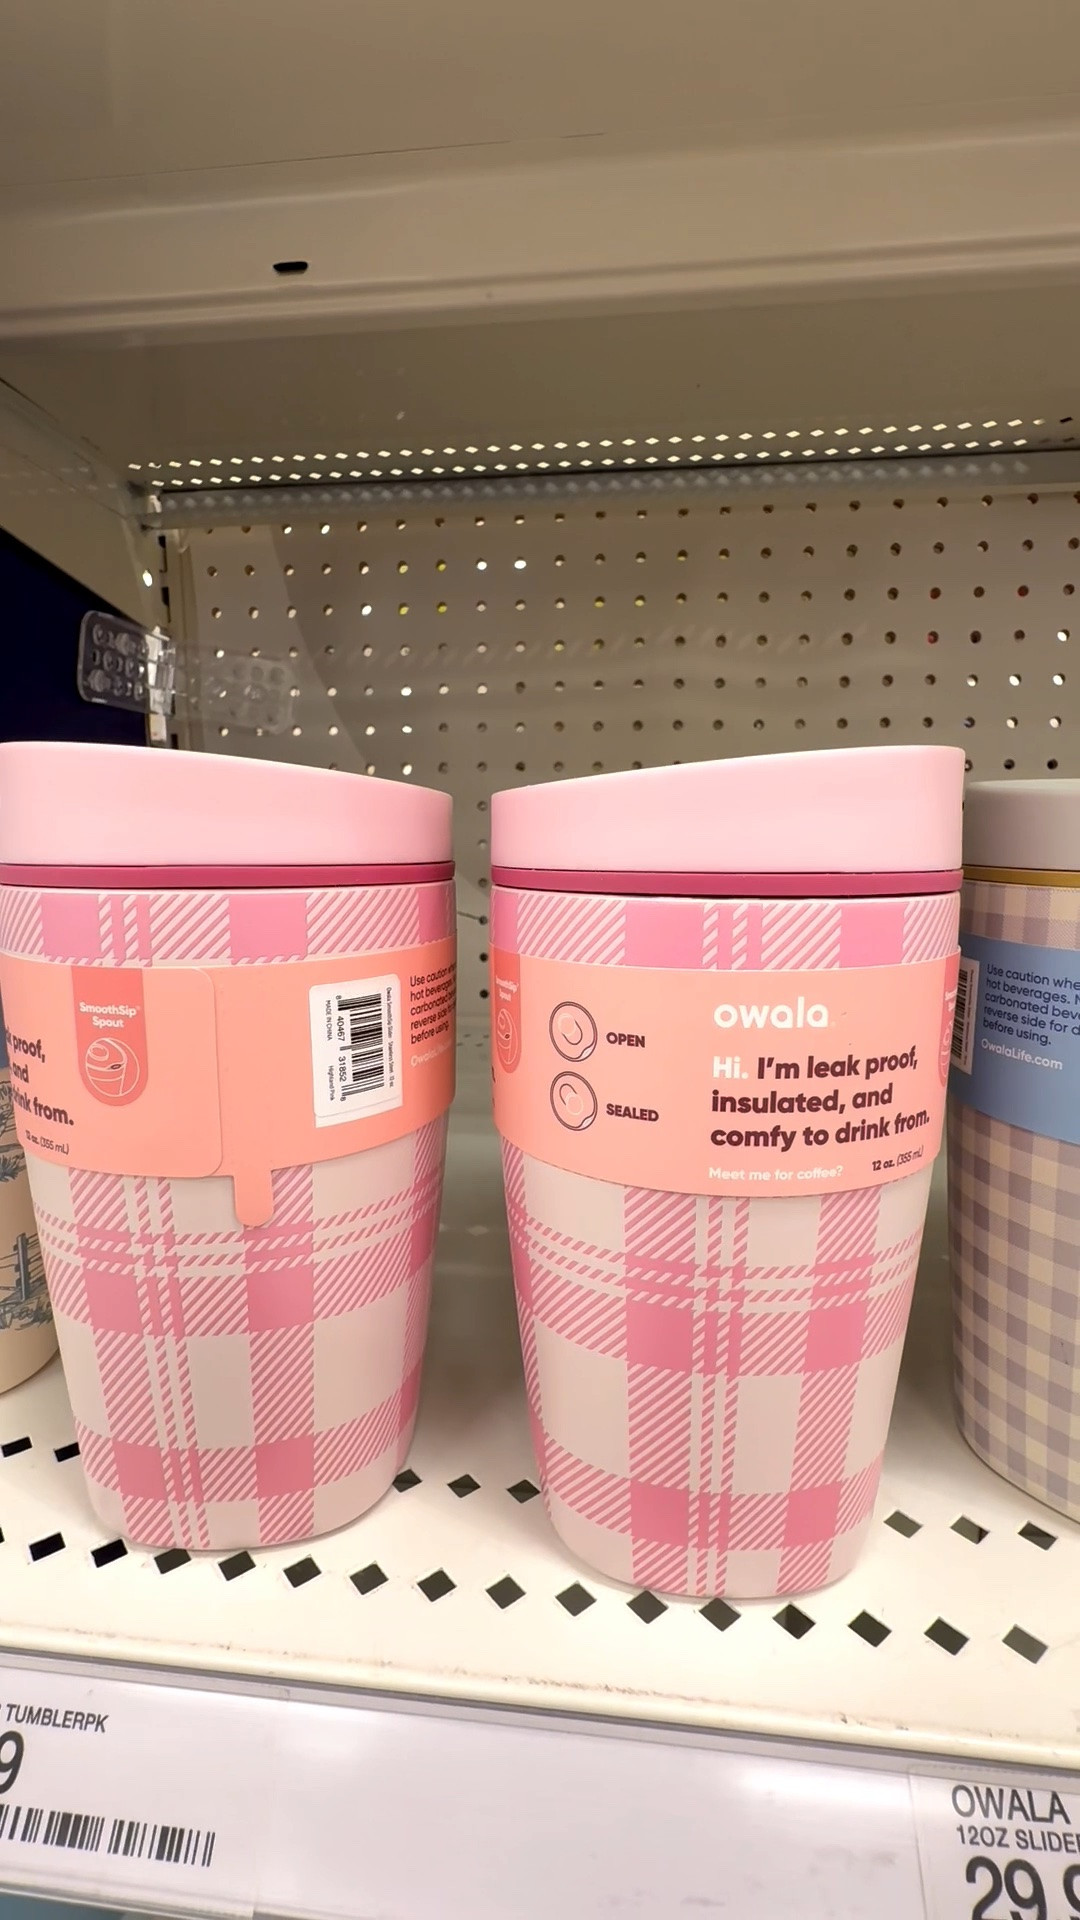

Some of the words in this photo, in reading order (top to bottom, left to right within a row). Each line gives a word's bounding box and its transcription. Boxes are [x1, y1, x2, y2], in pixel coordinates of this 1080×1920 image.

[410, 976, 425, 988] Use
[987, 964, 1003, 977] Use
[1006, 968, 1050, 985] caution
[410, 989, 424, 1002] hot
[986, 978, 1001, 990] hot
[1003, 981, 1070, 1004] beverages.
[713, 996, 829, 1029] owala
[984, 991, 1049, 1015] carbonated
[1052, 1005, 1080, 1020] bev
[92, 1015, 124, 1029] Spout
[337, 1016, 345, 1041] 40467
[411, 1012, 436, 1031] reverse
[983, 1017, 1014, 1035] before
[1016, 1026, 1052, 1046] using.
[984, 1005, 1019, 1022] reverse
[1021, 1014, 1046, 1029] side
[1050, 1020, 1068, 1033] for
[411, 1027, 435, 1044] before
[606, 1032, 645, 1048] OPEN
[12, 1034, 45, 1063] proof,
[981, 1038, 1063, 1070] OwalaLife.com
[12, 1061, 29, 1083] and
[713, 1055, 749, 1079] Hi.
[807, 1054, 861, 1078] leak
[865, 1045, 918, 1080] proof,
[711, 1089, 846, 1114] insulated,
[851, 1082, 893, 1109] and
[33, 1096, 74, 1126] from.
[606, 1103, 659, 1122] SEALED
[710, 1125, 797, 1152] comfy
[802, 1126, 829, 1146] to
[835, 1116, 890, 1144] drink
[894, 1109, 930, 1135] from.
[40, 1136, 54, 1150] (355
[55, 1143, 70, 1155] mL)
[708, 1167, 745, 1180] Meet
[749, 1168, 771, 1180] me
[774, 1167, 793, 1180] for
[797, 1165, 843, 1180] coffee?
[872, 1160, 882, 1171] 12
[883, 1159, 895, 1169] oz.
[897, 1150, 912, 1167] (355
[6, 1703, 109, 1733] TUMBLERPK
[952, 1784, 1071, 1825] OWALA
[956, 1825, 1010, 1848] 12OZ
